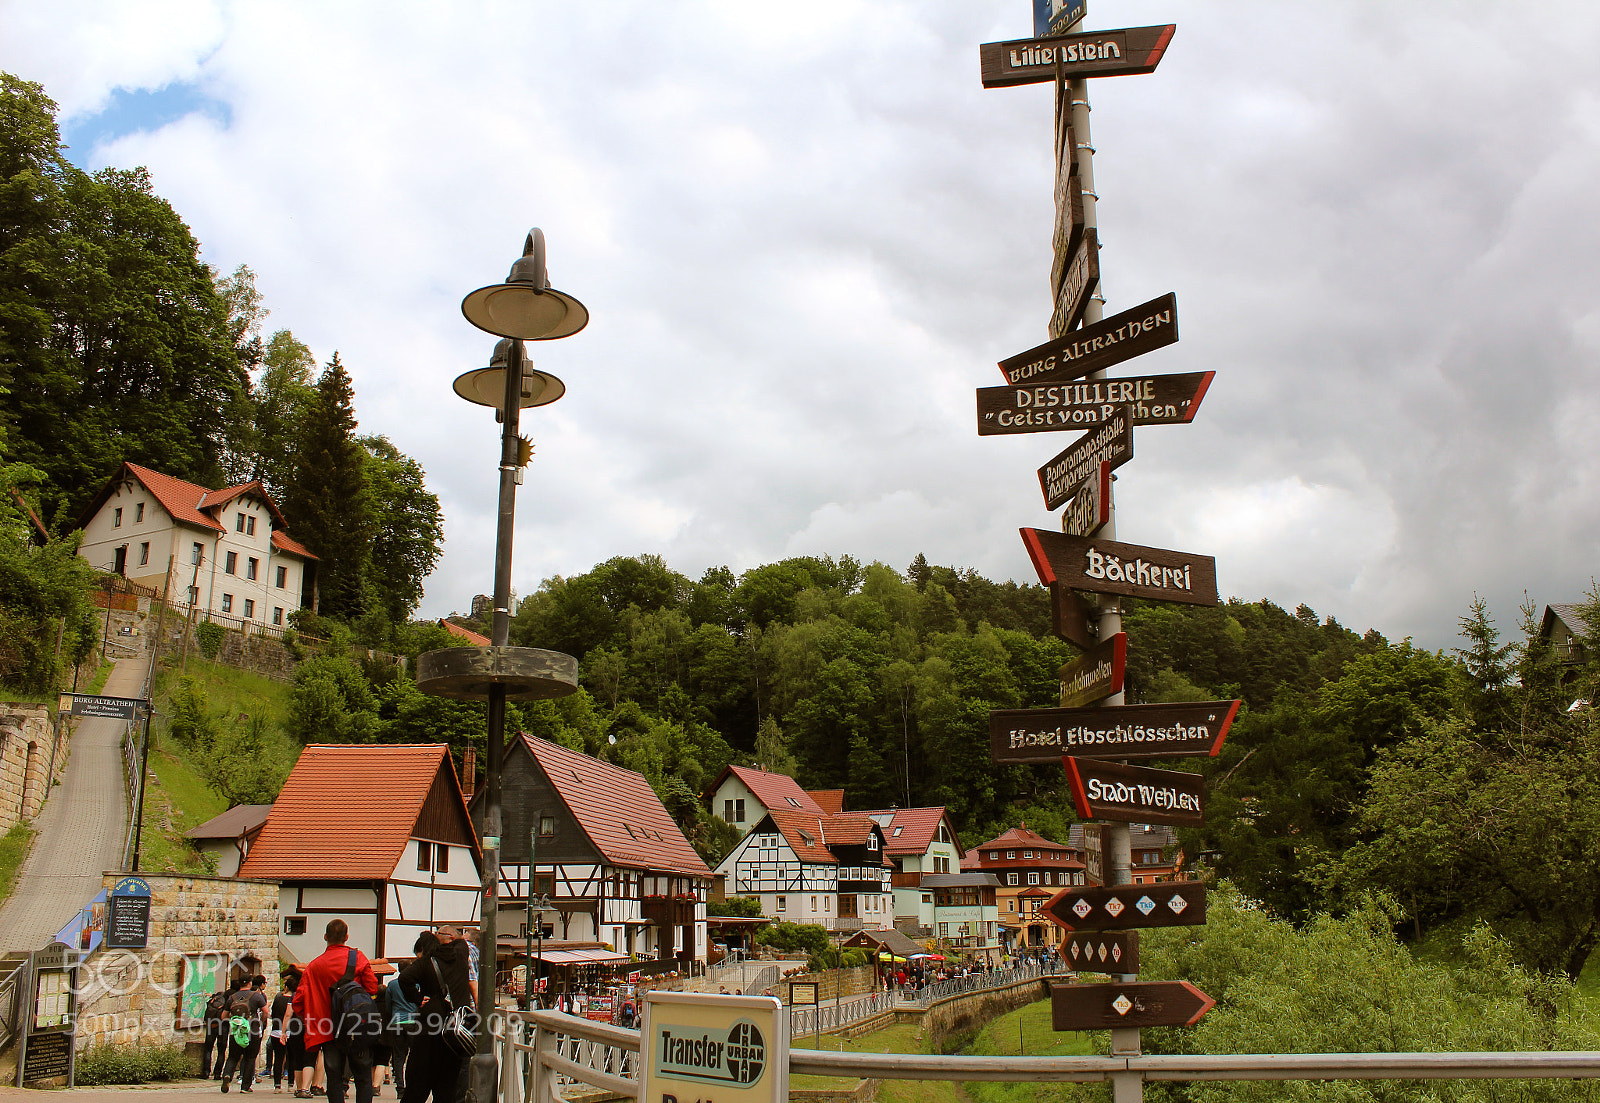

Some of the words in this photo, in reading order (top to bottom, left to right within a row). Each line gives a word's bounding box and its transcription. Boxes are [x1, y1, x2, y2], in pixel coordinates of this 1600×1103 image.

[1051, 14, 1069, 36] 500
[1071, 5, 1081, 19] m
[1009, 40, 1121, 67] Lilienstein
[1016, 380, 1155, 408] DESTILLERIE
[1058, 408, 1098, 424] von
[1085, 548, 1192, 590] Bäckerei
[1009, 726, 1062, 749] Hotel
[661, 1030, 725, 1070] Transfer
[726, 1045, 764, 1062] URBAN
